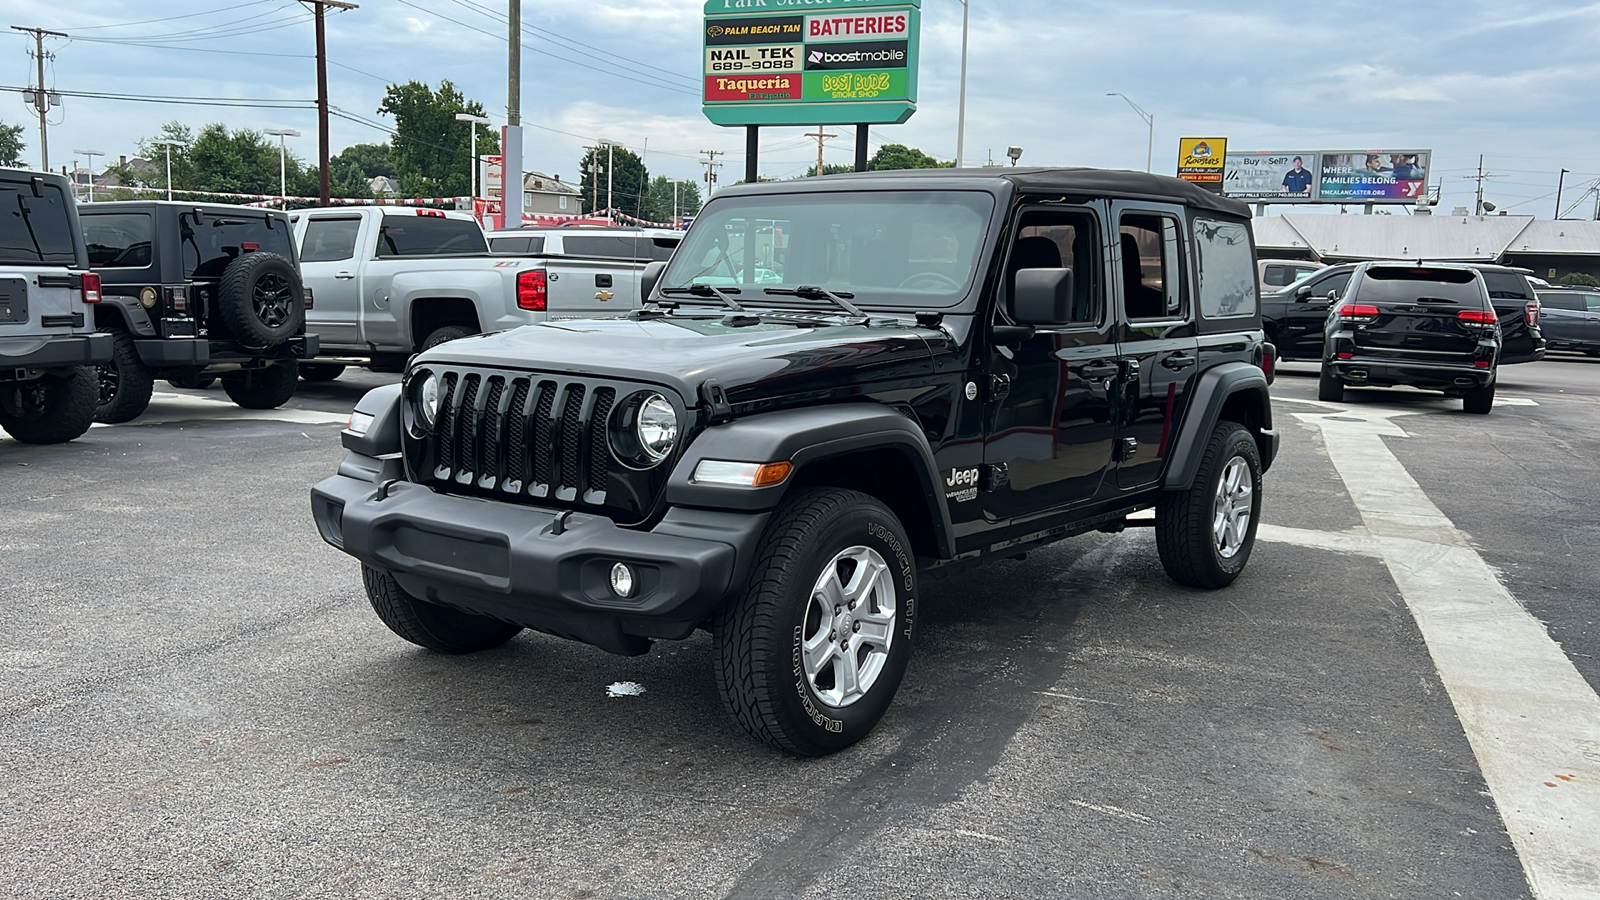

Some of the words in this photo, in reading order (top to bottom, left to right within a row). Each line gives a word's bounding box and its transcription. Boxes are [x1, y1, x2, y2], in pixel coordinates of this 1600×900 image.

[724, 26, 749, 35] PALM
[750, 25, 781, 34] BEACH
[782, 24, 801, 33] TAN
[809, 15, 906, 37] BATTERIES
[711, 49, 751, 61] NAIL
[758, 47, 795, 59] TEK
[712, 60, 794, 71] 689-9088
[858, 90, 879, 98] SHOP
[1184, 155, 1219, 166] Roosters
[1243, 158, 1259, 166] Buy
[1268, 157, 1288, 165] Sell?
[1322, 166, 1353, 174] WHERE
[1321, 176, 1360, 185] FAMILIES
[1361, 176, 1399, 185] BELONG.
[1409, 306, 1428, 314] Jeep
[946, 467, 979, 487] Jeep
